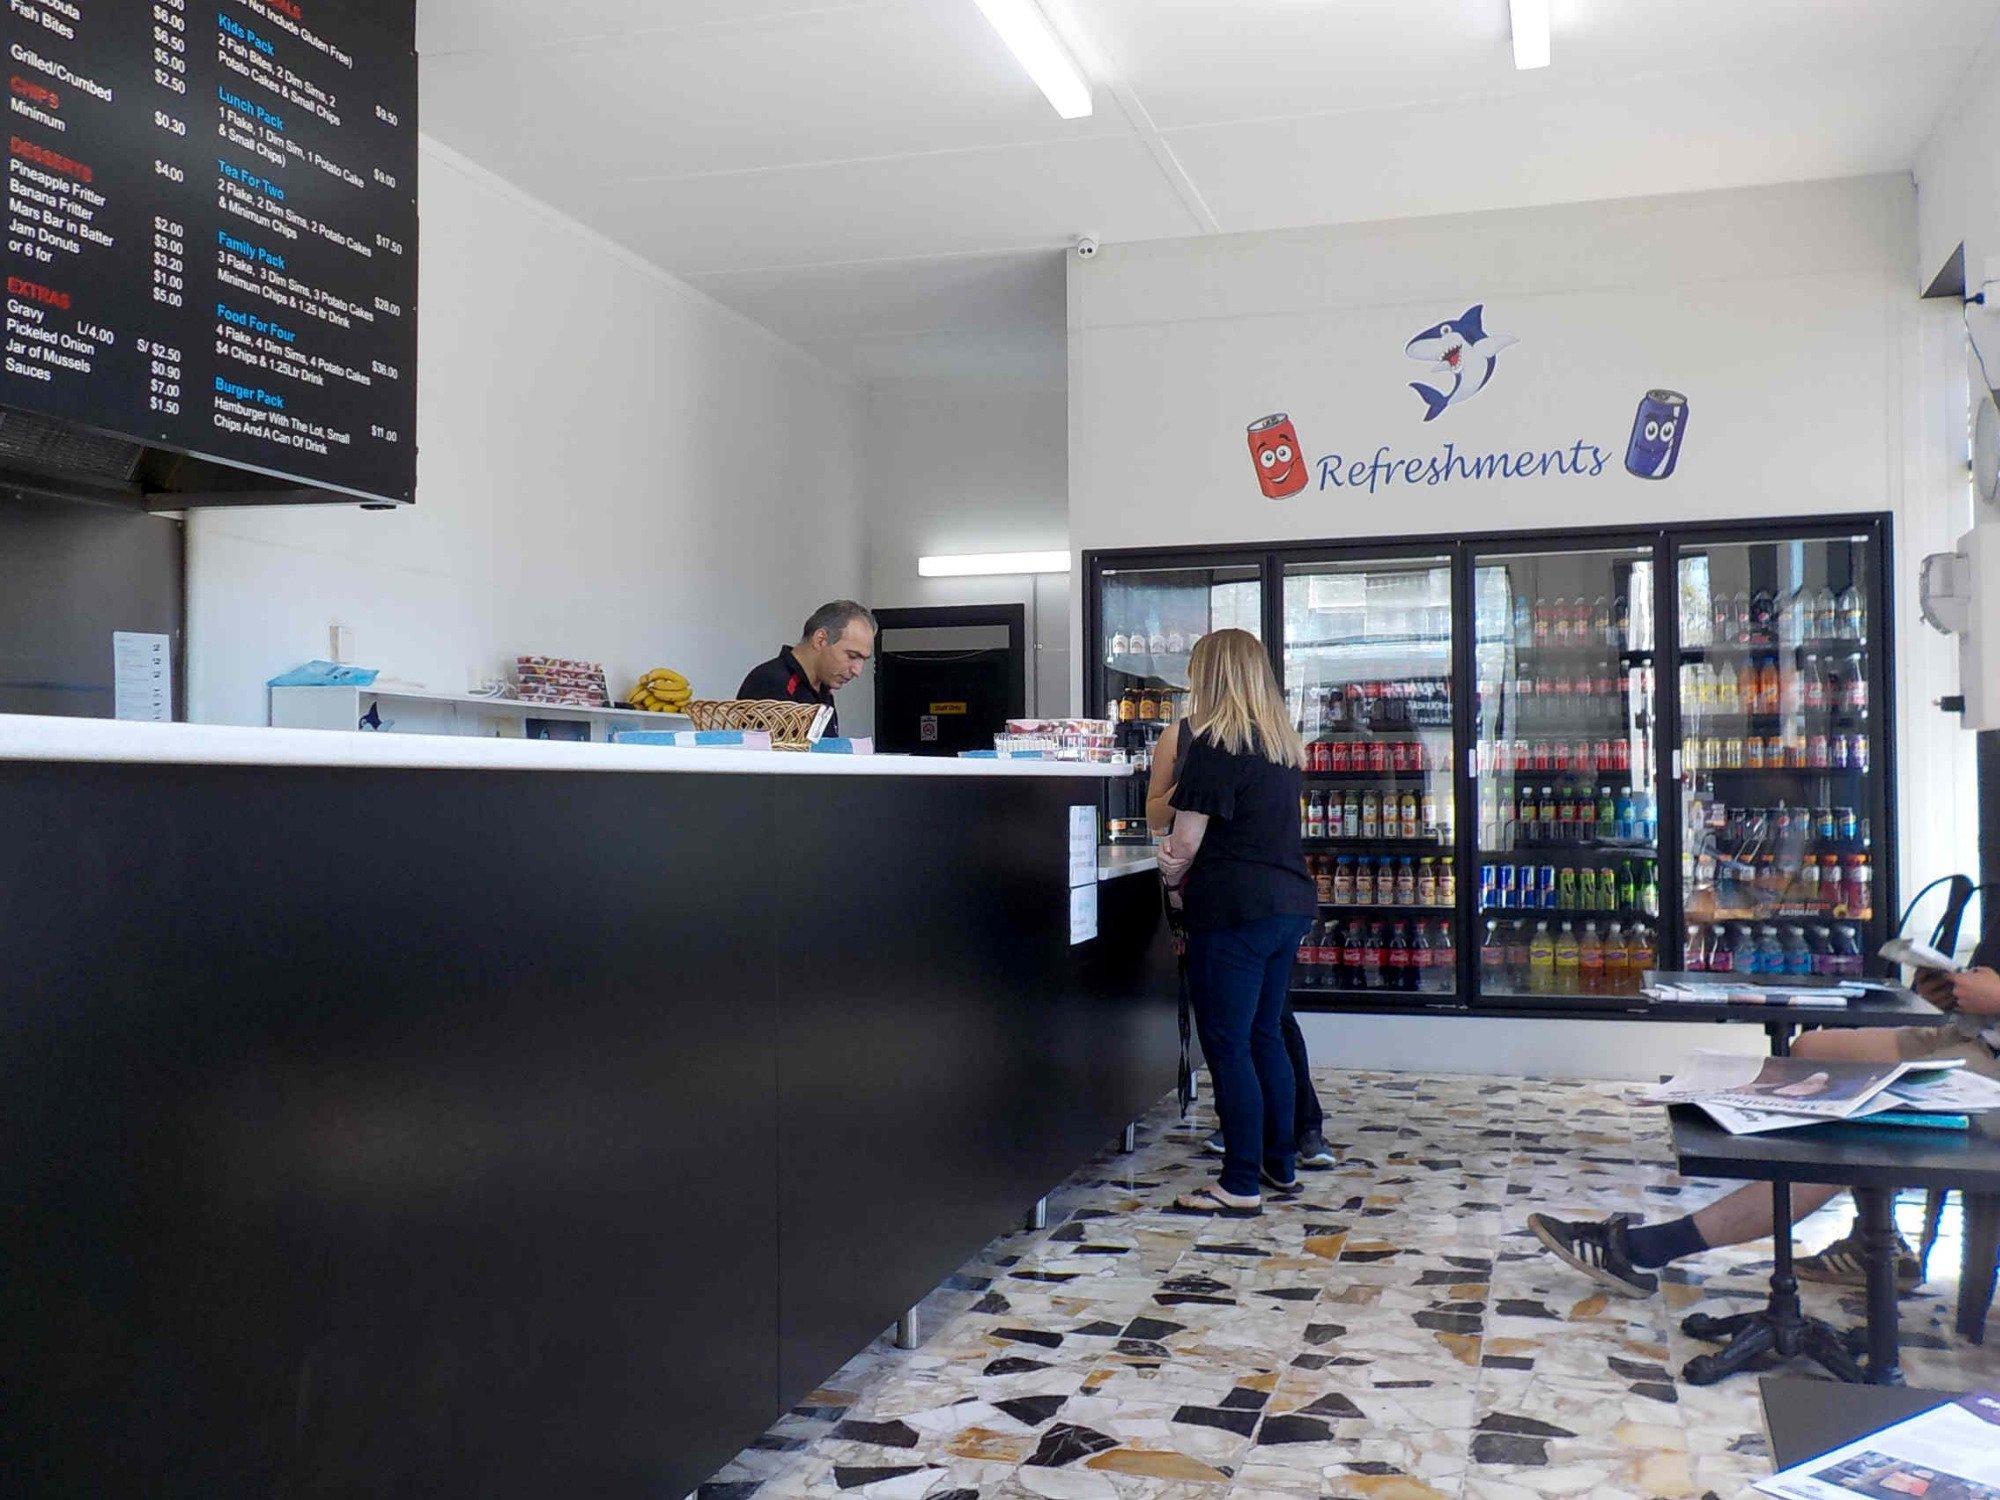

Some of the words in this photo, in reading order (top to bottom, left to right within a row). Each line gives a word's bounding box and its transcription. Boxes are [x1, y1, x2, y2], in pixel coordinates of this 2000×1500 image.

[11, 0, 39, 22] Fish
[42, 12, 74, 39] Bites
[153, 5, 185, 32] $6.00
[218, 13, 245, 39] Kids
[246, 29, 275, 57] Pack
[267, 7, 300, 36] Include
[300, 28, 329, 52] Gluten
[329, 45, 353, 69] Free)
[153, 26, 185, 53] $6.50
[11, 44, 112, 102] Grilled/Crumbed
[154, 48, 186, 74] $5.00
[218, 33, 225, 46] 2
[227, 37, 248, 58] Fish
[277, 66, 284, 79] 2
[285, 70, 303, 90] Dim
[329, 94, 336, 107] 2
[154, 68, 186, 95] $2.50
[218, 51, 250, 76] Potato
[251, 68, 280, 93] Cakes
[281, 86, 289, 98] &
[290, 89, 316, 113] Small
[316, 105, 341, 127] Chips
[11, 97, 66, 132] Minimum
[154, 111, 186, 136] $0.30
[218, 86, 255, 116] Lunch
[256, 106, 284, 131] Pack
[218, 124, 226, 137] &
[228, 128, 256, 151] Small
[257, 143, 287, 168] Chips)
[219, 107, 225, 118] 1
[227, 110, 257, 136] Flake,
[258, 127, 264, 138] 1
[266, 130, 285, 148] Dim
[307, 152, 313, 163] 1
[314, 155, 342, 178] Potato
[343, 169, 365, 189] Cake
[10, 158, 70, 193] Pineapple
[73, 183, 106, 206] Fritter
[154, 160, 184, 183] $4.00
[218, 159, 239, 180] Tea
[241, 169, 260, 190] For
[262, 179, 284, 200] Two
[10, 178, 57, 208] Banana
[60, 197, 94, 220] Fritter
[218, 195, 226, 209] &
[228, 199, 271, 228] Minimum
[272, 219, 298, 240] Chips
[218, 178, 226, 191] 2
[227, 182, 256, 206] Flake,
[257, 196, 264, 208] 2
[265, 199, 284, 217] Dim
[311, 220, 318, 232] 2
[319, 223, 346, 246] Potato
[347, 237, 372, 258] Cakes
[9, 218, 35, 239] Jam
[38, 228, 81, 254] Donuts
[10, 198, 40, 220] Mars
[42, 210, 64, 229] Bar
[67, 220, 77, 234] in
[80, 223, 114, 247] Batter
[154, 216, 183, 237] $2.00
[8, 240, 22, 252] or
[24, 242, 33, 257] 6
[35, 246, 53, 263] for
[153, 252, 183, 272] $3.20
[154, 234, 183, 255] $3.00
[217, 230, 256, 260] Family
[257, 249, 286, 270] Pack
[152, 287, 183, 307] $5.00
[153, 269, 183, 290] $1.00
[217, 251, 226, 263] 3
[260, 267, 267, 280] 3
[268, 270, 287, 288] Dim
[313, 289, 320, 301] 3
[321, 291, 348, 312] Potato
[349, 303, 375, 322] Cakes
[217, 268, 261, 295] Minimum
[262, 286, 288, 306] Chips
[289, 296, 297, 308] &
[299, 300, 317, 316] 1.25
[328, 311, 351, 329] Drink
[7, 299, 45, 323] Gravy
[216, 304, 247, 326] Food
[249, 314, 269, 332] For
[270, 323, 296, 343] Four
[6, 318, 58, 345] Pickeled
[61, 335, 95, 355] Onion
[6, 338, 26, 354] Jar
[29, 345, 41, 359] of
[43, 349, 91, 373] Mussels
[152, 342, 182, 363] $2.50
[216, 324, 224, 336] 4
[226, 326, 254, 348] Flake,
[255, 337, 263, 349] 4
[264, 339, 283, 356] Dim
[310, 356, 317, 368] 4
[318, 357, 345, 377] Potato
[346, 368, 371, 386] Cakes
[5, 357, 52, 381] Sauces
[151, 360, 181, 380] $0.90
[215, 340, 229, 355] $4
[230, 346, 258, 366] Chips
[259, 356, 267, 368] &
[300, 368, 325, 386] Drink
[150, 378, 180, 398] $7.00
[150, 396, 180, 416] $1.50
[214, 376, 254, 401] Burger
[257, 389, 286, 409] Pack
[213, 414, 242, 432] Chips
[242, 422, 263, 438] And
[263, 427, 271, 440] A
[272, 430, 291, 445] Can
[292, 436, 303, 449] Of
[305, 438, 329, 455] Drink
[214, 396, 268, 423] Hamburger
[268, 411, 290, 428] With
[291, 417, 309, 434] The
[326, 427, 350, 445] Small
[1316, 438, 1612, 494] Refreshments
